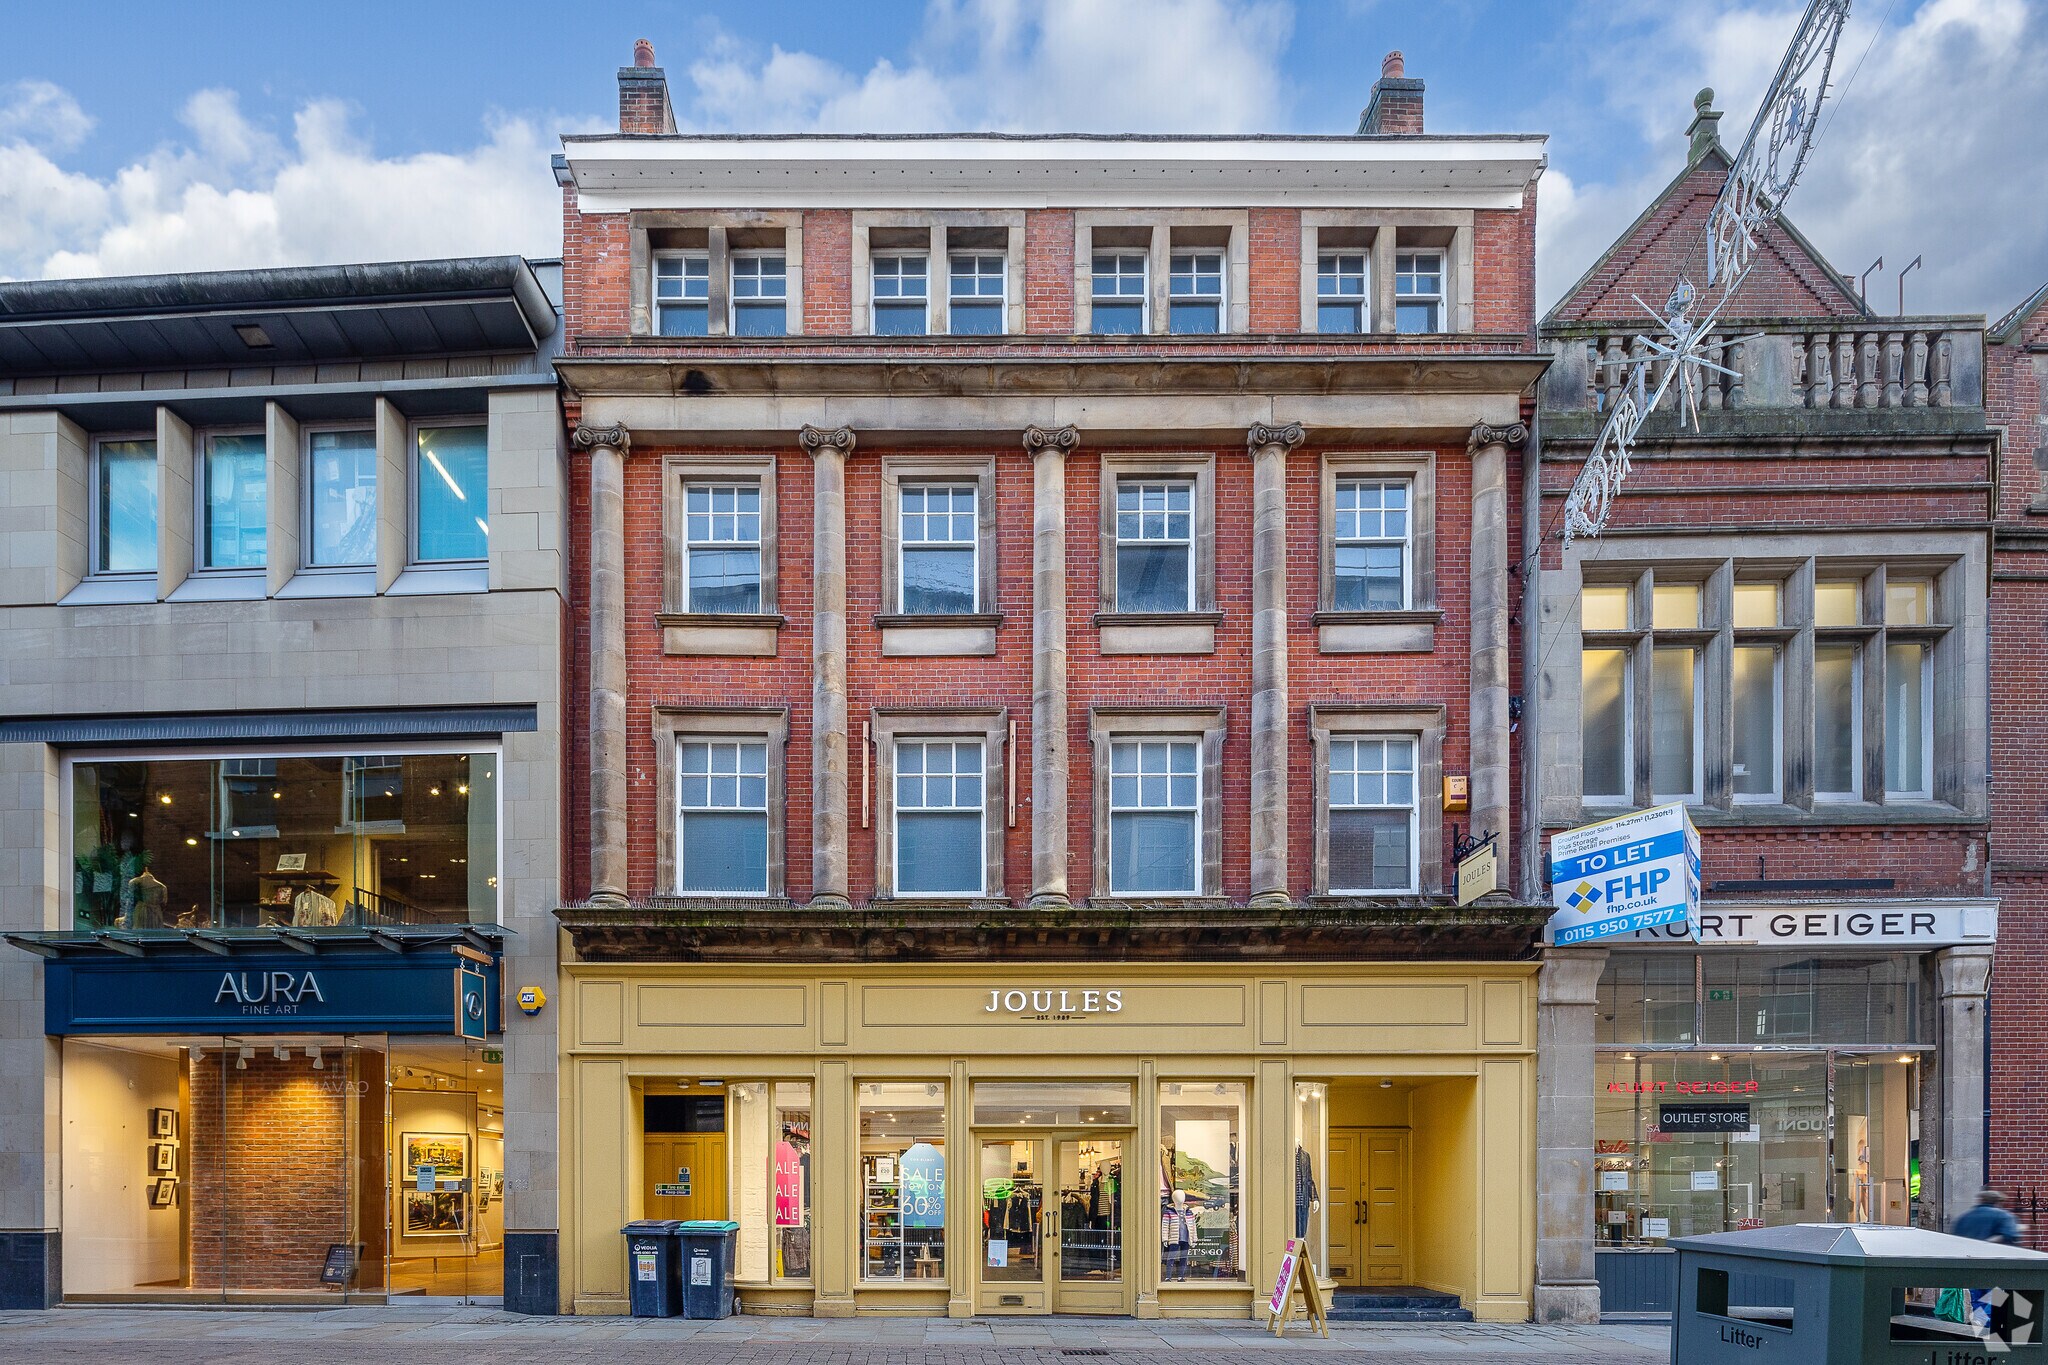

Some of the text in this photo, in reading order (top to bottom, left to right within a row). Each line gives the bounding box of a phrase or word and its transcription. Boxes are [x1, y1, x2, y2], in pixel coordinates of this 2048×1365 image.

[1557, 832, 1580, 844] Ground
[1580, 828, 1597, 839] Floor
[1597, 824, 1613, 834] Sales
[1557, 836, 1598, 851] Plus Storage
[1557, 833, 1631, 858] Prime Retail Premises
[1577, 842, 1654, 873] TO LET
[1462, 861, 1492, 886] JOULES
[1605, 867, 1671, 904] FHP
[1606, 896, 1657, 914] fhp.co.uk
[1564, 908, 1675, 941] 0115 950 7577
[1769, 913, 1936, 937] GEIGER
[214, 971, 325, 1003] AURA
[522, 994, 535, 1002] ADT
[985, 990, 1123, 1012] JOULES
[242, 1004, 299, 1015] FINE ART
[1607, 1081, 1759, 1094] KURT GEIGER
[1663, 1113, 1747, 1124] OUTLET STORE
[1596, 1139, 1630, 1153] Sale
[776, 1162, 798, 1174] ALE
[902, 1168, 943, 1181] SALE
[776, 1184, 798, 1197] ALE
[776, 1207, 798, 1220] ALE
[1737, 1218, 1764, 1228] SALE
[1720, 1325, 1763, 1350] Litter
[1931, 1351, 1997, 1365] Litter
